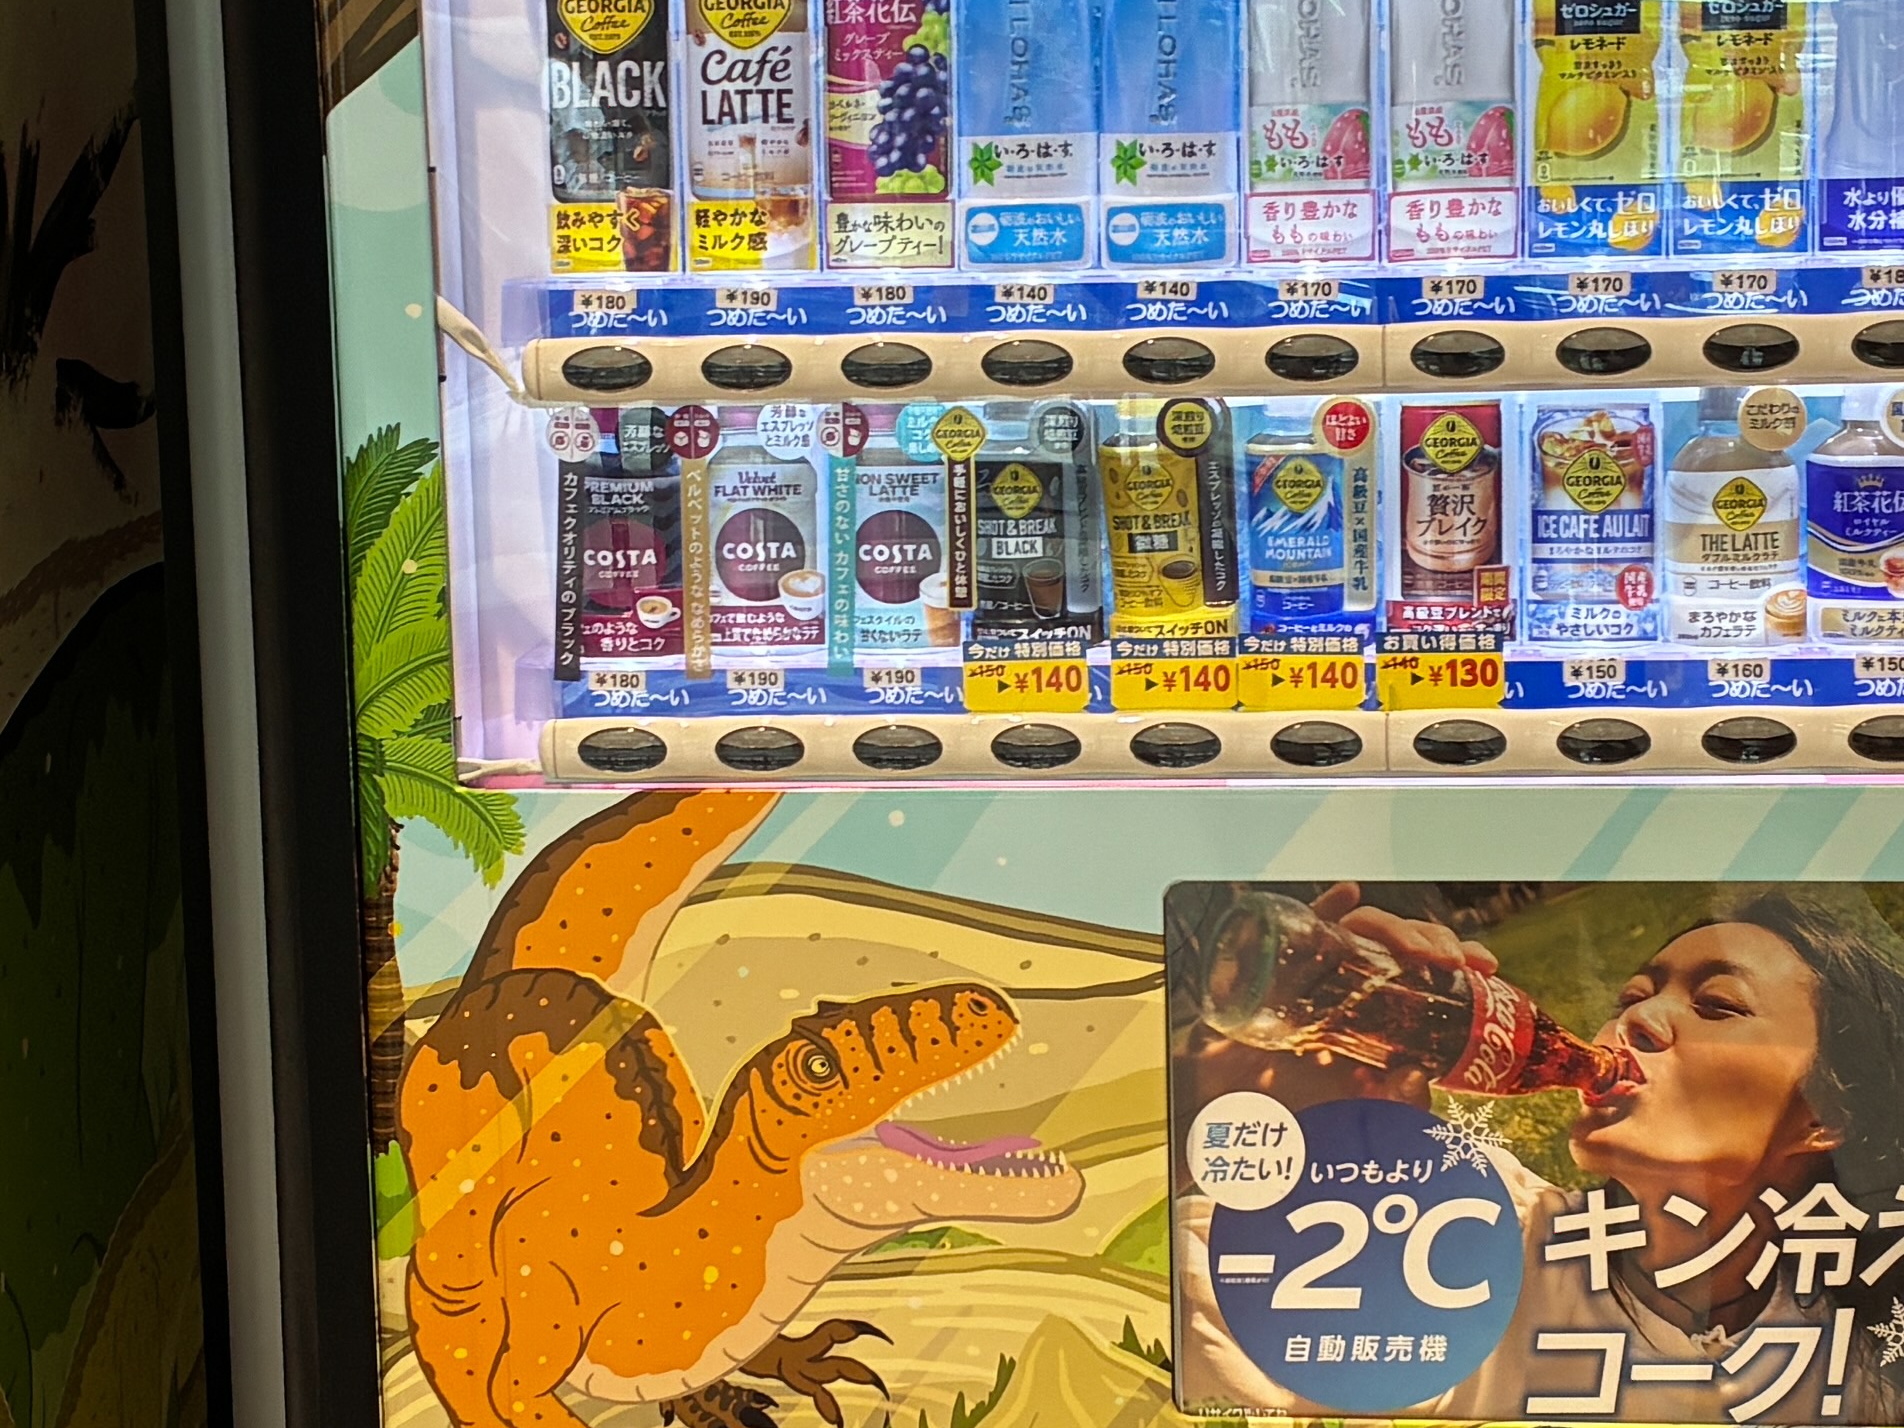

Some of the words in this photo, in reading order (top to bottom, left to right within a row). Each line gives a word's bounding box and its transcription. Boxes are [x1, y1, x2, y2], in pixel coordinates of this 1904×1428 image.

[701, 46, 793, 86] Café
[552, 58, 667, 110] BLACK
[701, 89, 794, 125] LATTE
[557, 209, 639, 231] 飲みやすく
[1263, 202, 1357, 221] 香り豊かな
[697, 231, 768, 252] ミルク感
[1014, 227, 1066, 246] 天然水
[1424, 437, 1479, 449] GEORGIA
[714, 485, 750, 497] FLAT
[755, 483, 802, 497] WHITE
[868, 486, 920, 498] LATTE
[1427, 493, 1476, 516] 贅沢
[1417, 517, 1487, 537] ブレイク
[722, 542, 797, 561] COSTA
[996, 539, 1039, 556] BLACK
[1267, 535, 1331, 548] EMERALD
[584, 549, 657, 566] COSTA
[1265, 547, 1332, 560] MOUNTAIN
[738, 563, 780, 573] COFFEE
[1290, 661, 1359, 690] ¥140
[1429, 658, 1498, 688] ¥130
[1204, 1122, 1288, 1150] 夏だけ
[1201, 1155, 1292, 1183] 冷たい!
[1309, 1159, 1434, 1183] いつもより
[1284, 1334, 1448, 1364] 自動販売機
